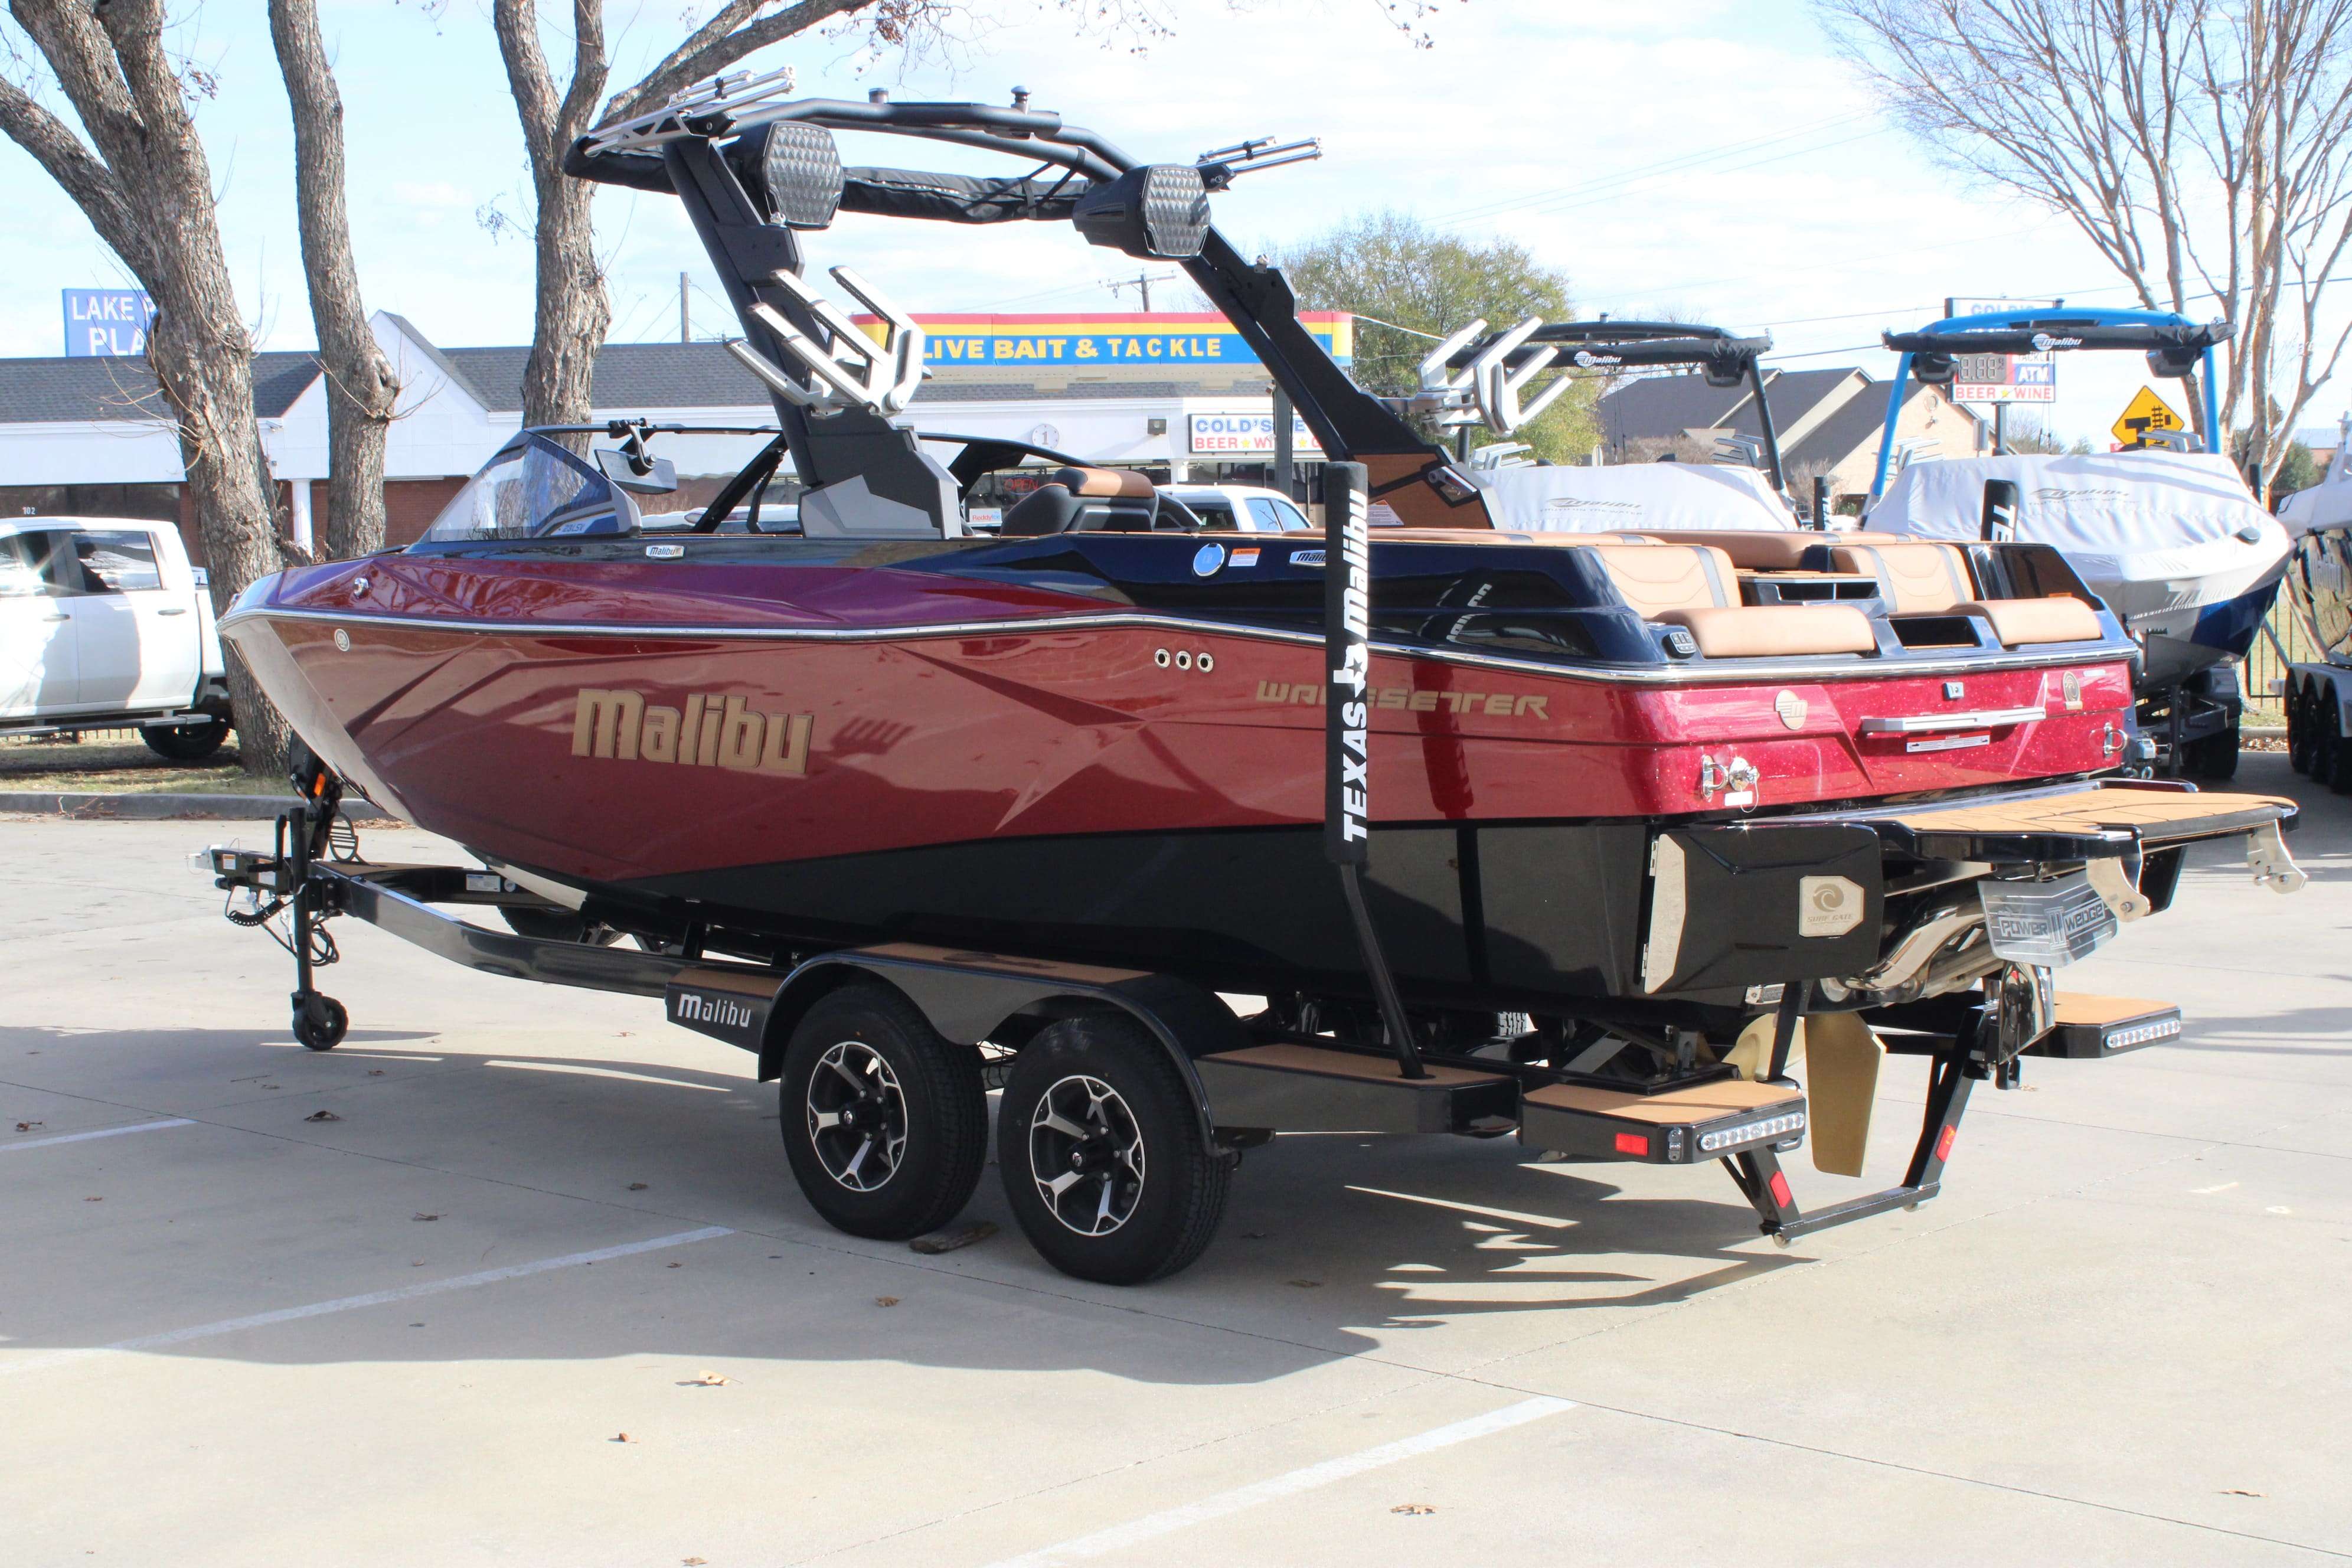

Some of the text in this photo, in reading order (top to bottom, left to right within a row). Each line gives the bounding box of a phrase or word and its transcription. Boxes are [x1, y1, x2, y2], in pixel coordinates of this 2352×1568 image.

[72, 296, 135, 321] LAKE
[89, 328, 145, 356] PLA
[994, 339, 1066, 358] BAIT
[1075, 338, 1099, 358] &
[1108, 338, 1221, 357] TACKLE
[2018, 366, 2049, 382] ATM
[1956, 387, 2052, 399] BEER WINE
[1195, 419, 1274, 433] COLD'S
[1195, 437, 1238, 449] BEER
[1004, 478, 1039, 492] OPEN
[22, 507, 35, 515] 102
[1343, 489, 1368, 639] Malibu
[1256, 681, 1549, 720] WASETTER
[572, 688, 814, 773] Malibu
[1342, 702, 1367, 842] TEXAS
[677, 993, 752, 1028] Malibu
